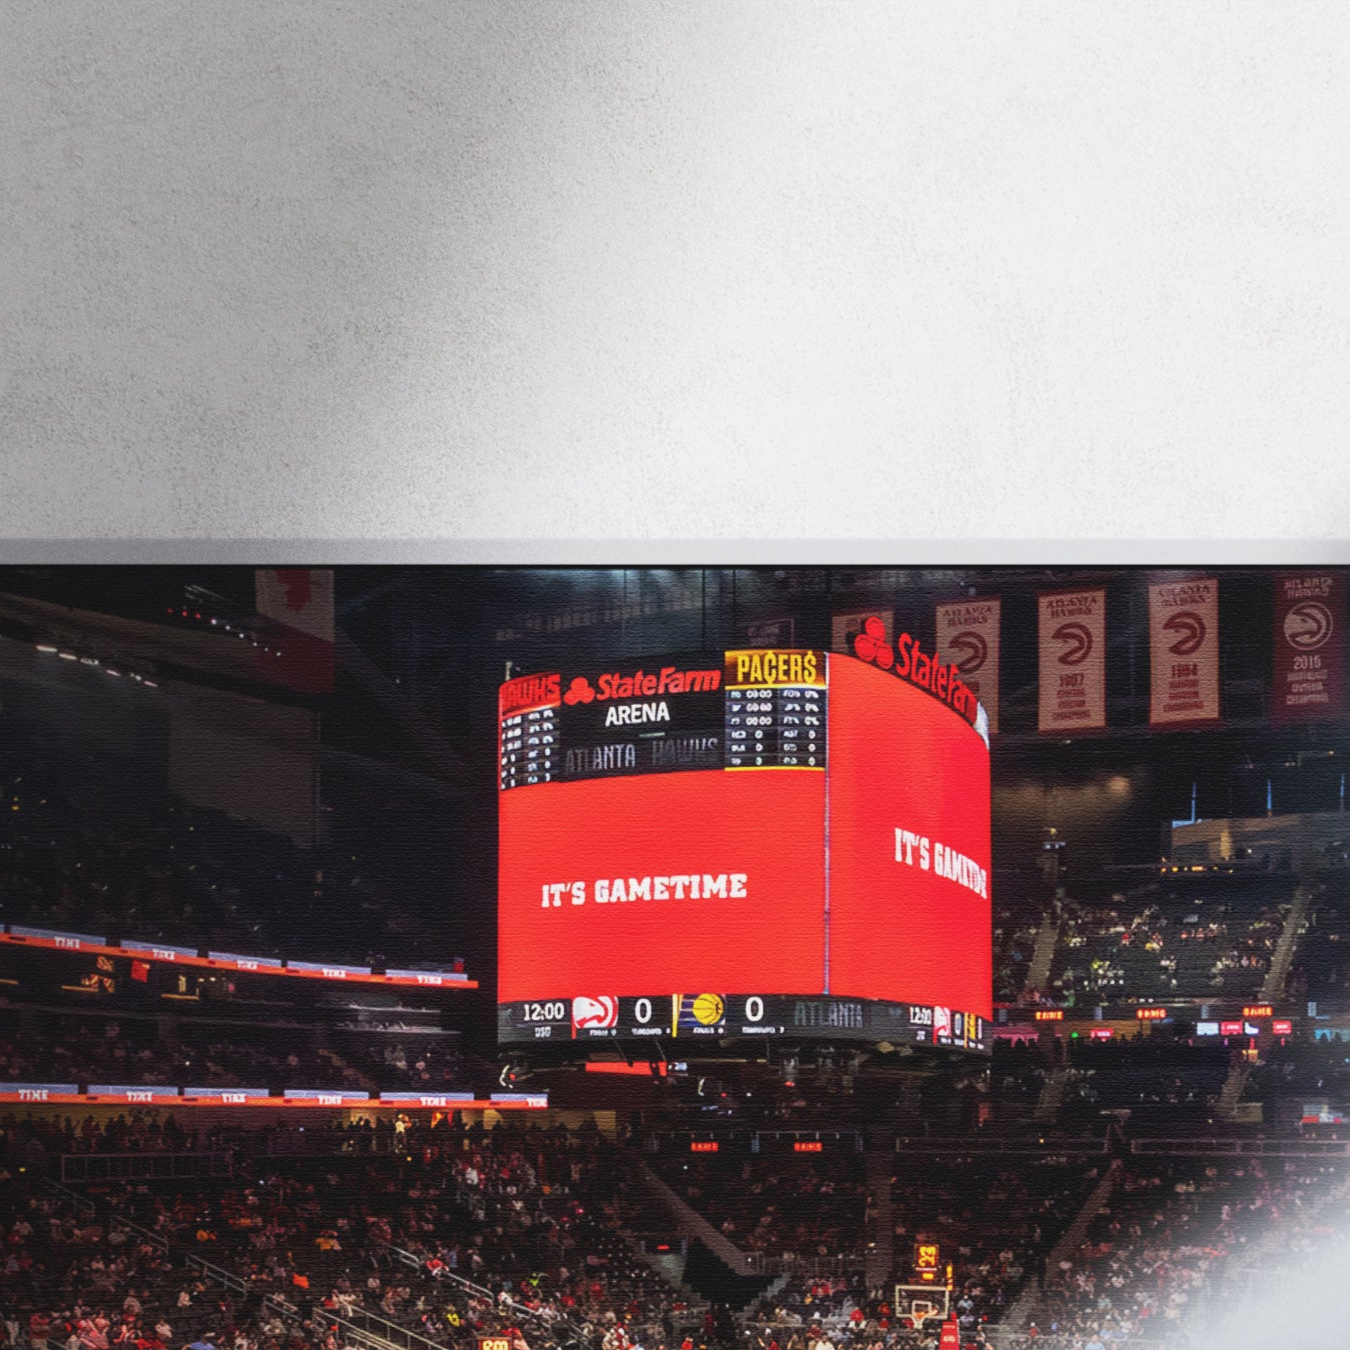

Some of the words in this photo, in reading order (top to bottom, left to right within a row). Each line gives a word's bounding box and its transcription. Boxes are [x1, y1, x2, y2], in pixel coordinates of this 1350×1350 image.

[737, 651, 817, 684] PACERS
[605, 702, 670, 727] ARENA
[895, 827, 930, 871] IT'S
[541, 882, 586, 907] IT'S
[595, 874, 747, 903] GAMETIME
[524, 1002, 565, 1021] 12:00
[635, 998, 652, 1024] 0
[745, 996, 764, 1022] 0
[18, 1089, 48, 1100] TIME
